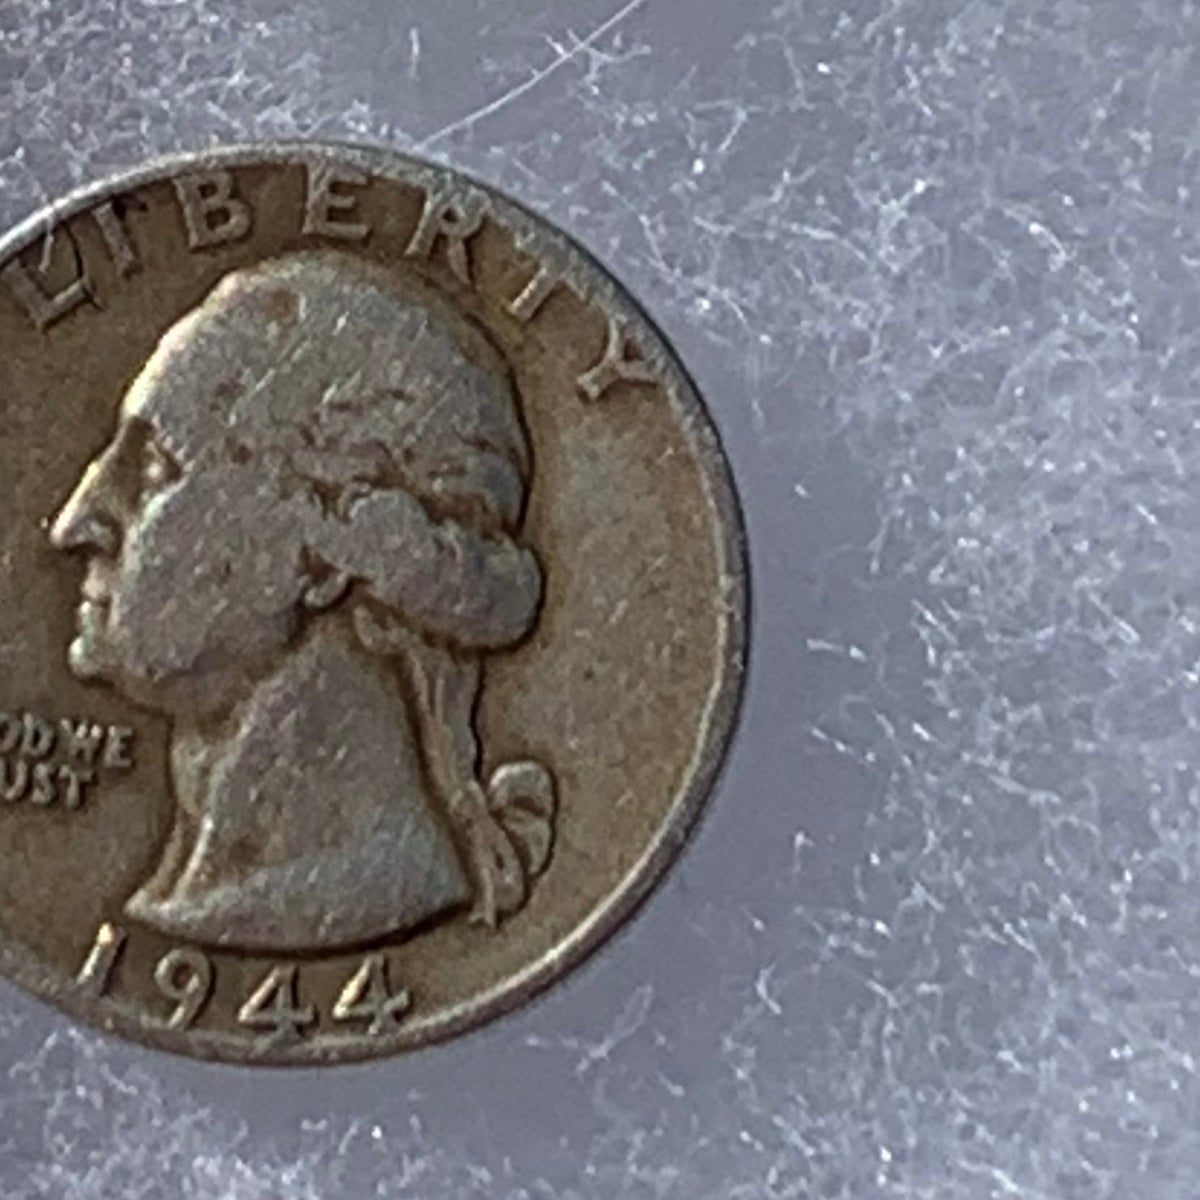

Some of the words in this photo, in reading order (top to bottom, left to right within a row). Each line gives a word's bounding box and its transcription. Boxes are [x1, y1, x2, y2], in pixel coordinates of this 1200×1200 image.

[4, 164, 662, 402] LIBERTY
[59, 716, 133, 768] WE
[74, 921, 412, 1038] 1944
